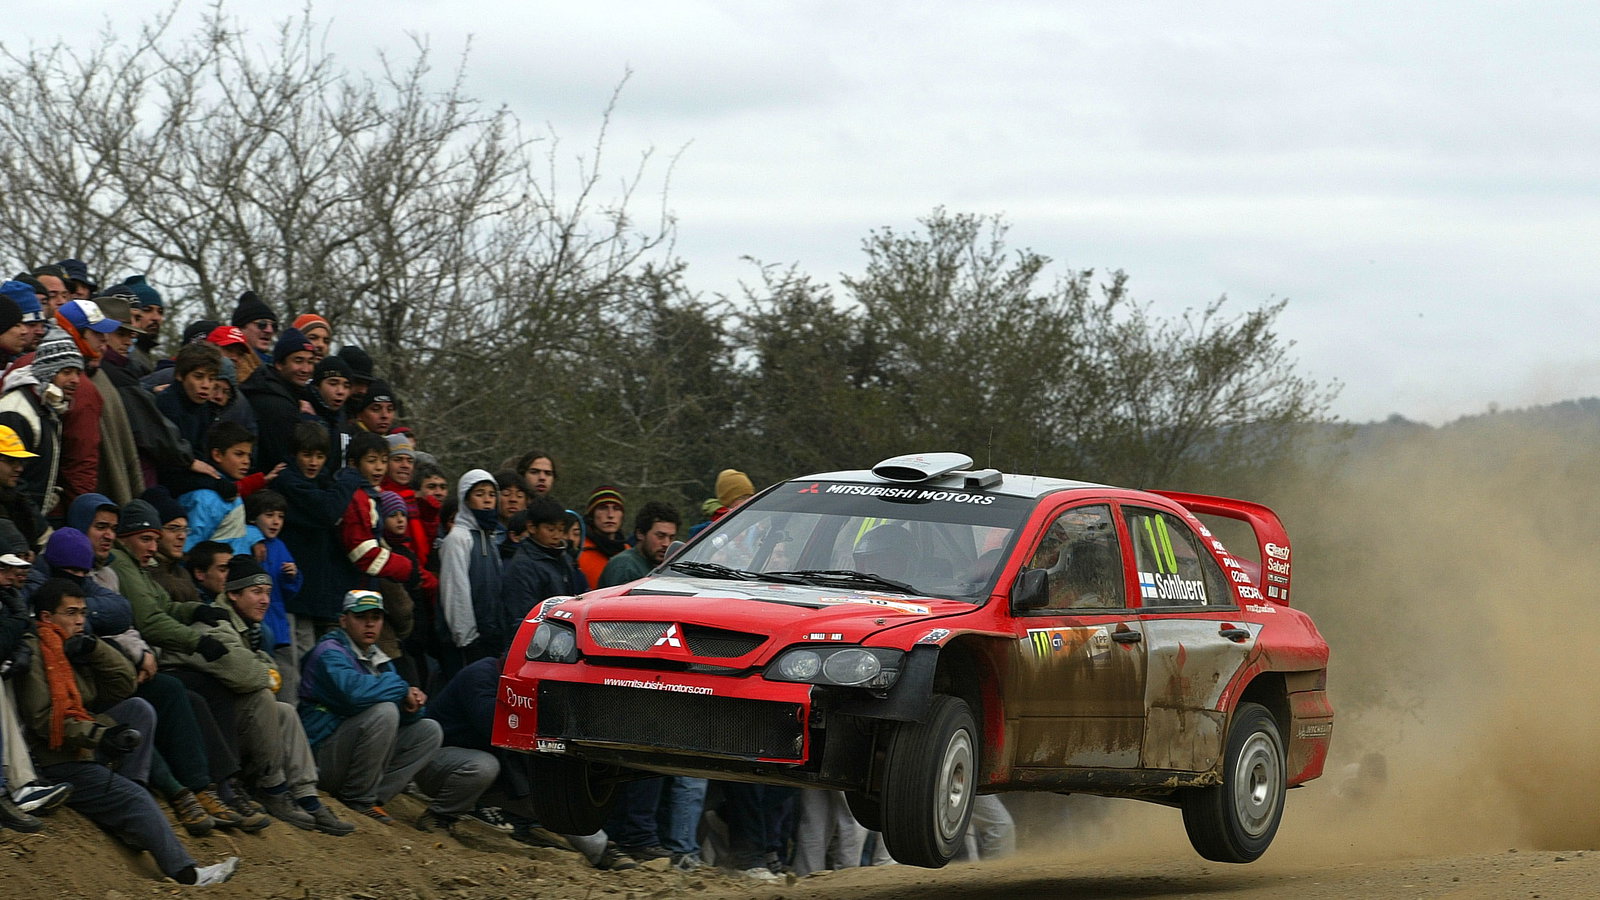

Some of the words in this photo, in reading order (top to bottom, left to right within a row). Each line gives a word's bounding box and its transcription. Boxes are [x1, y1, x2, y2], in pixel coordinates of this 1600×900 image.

[826, 484, 913, 499] MITSUBISHI
[917, 490, 996, 505] MOTORS
[1145, 514, 1178, 574] 10
[1156, 573, 1208, 606] Sohlberg
[1034, 632, 1049, 657] 10
[603, 678, 714, 695] www.mitsubishi-motors.com
